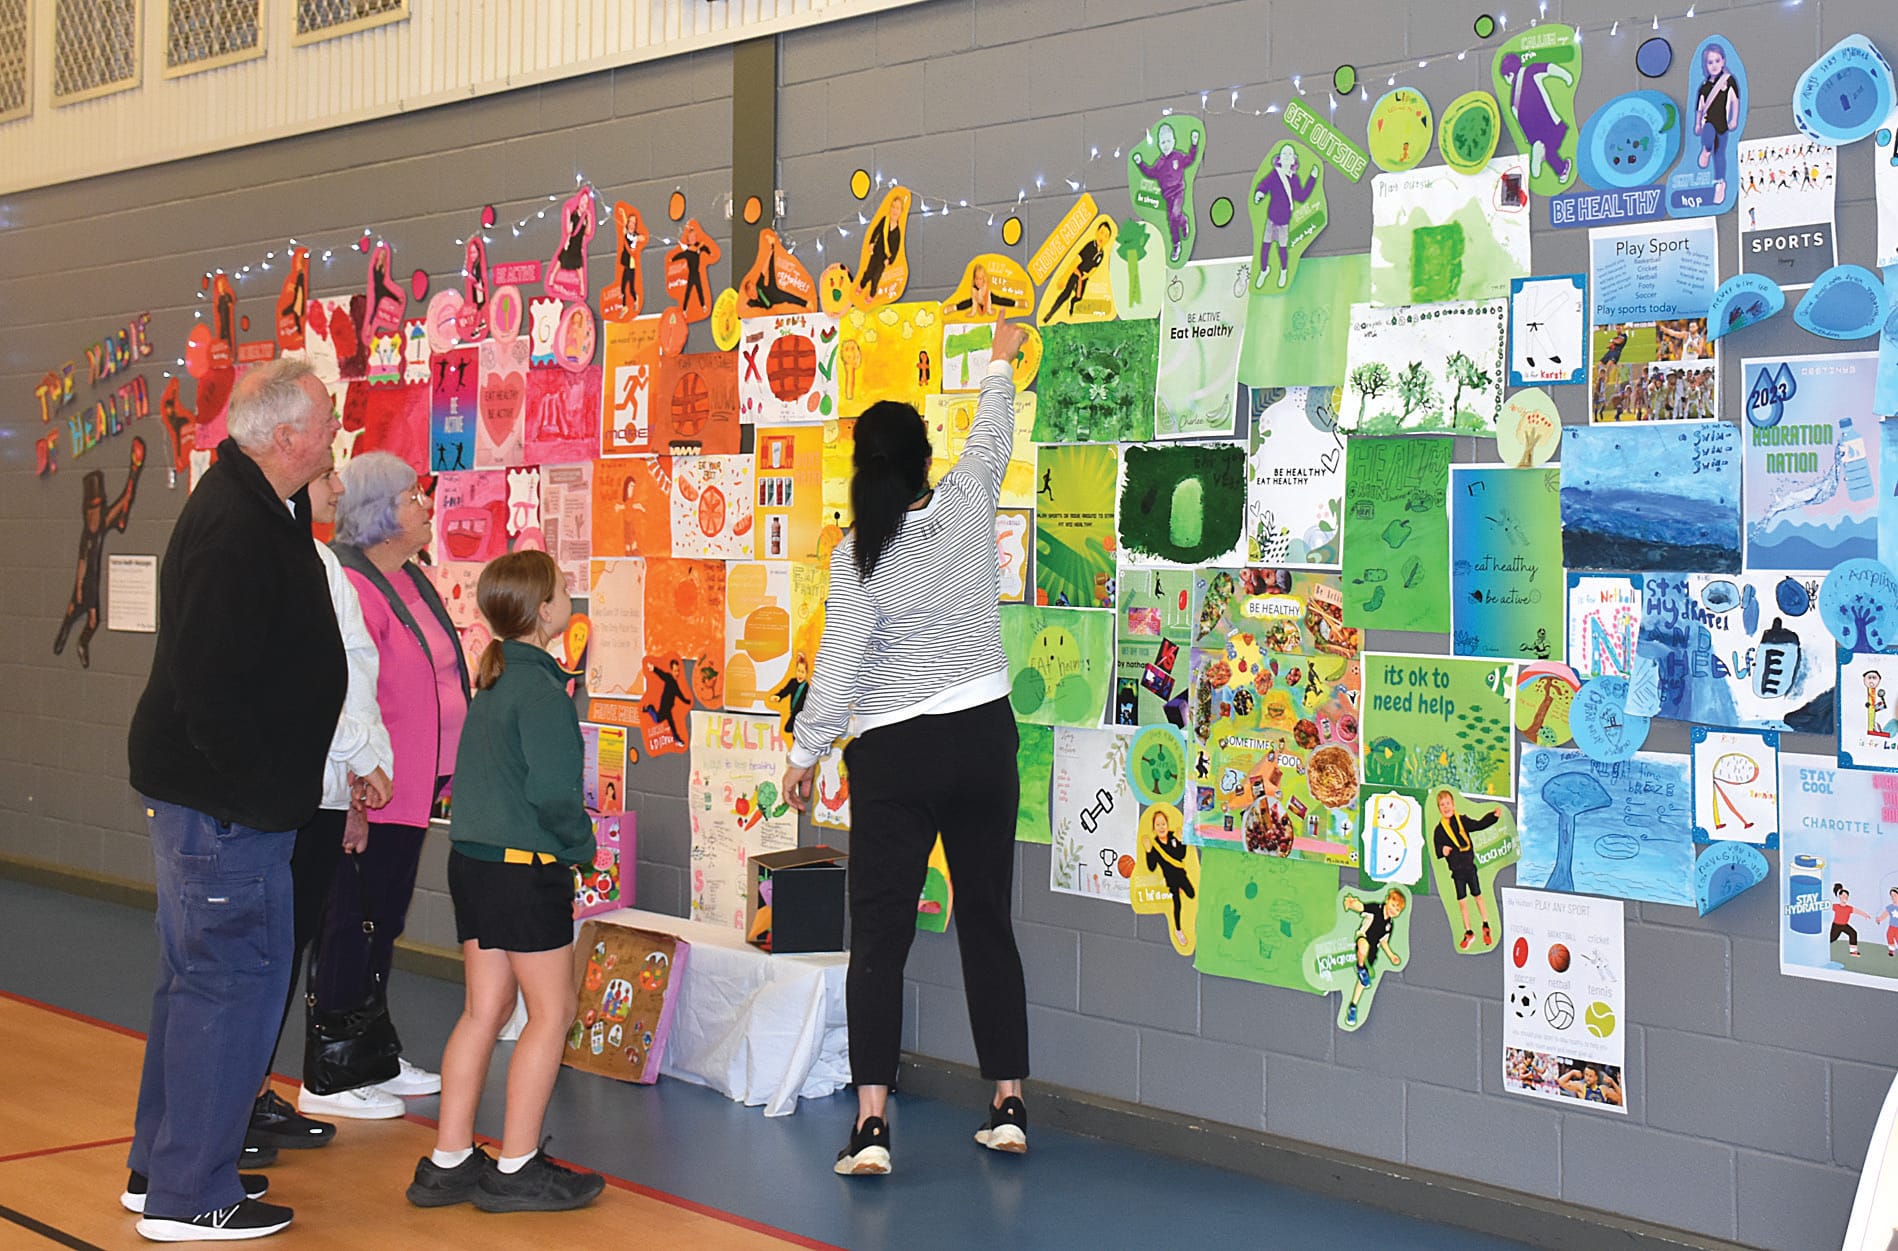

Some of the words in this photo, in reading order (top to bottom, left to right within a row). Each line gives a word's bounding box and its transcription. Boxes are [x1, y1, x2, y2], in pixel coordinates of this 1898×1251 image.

[1284, 102, 1315, 135] GET
[1310, 123, 1367, 180] OUTSIDE
[1553, 199, 1576, 224] BE
[1578, 189, 1661, 221] HEALTHY
[1681, 194, 1702, 208] hop
[1032, 233, 1066, 280] MOVE
[1060, 200, 1093, 240] MORE
[1616, 241, 1645, 258] Play
[1649, 238, 1689, 257] Sport
[1752, 232, 1823, 253] SPORTS
[1635, 291, 1657, 299] Soccer
[1187, 313, 1196, 323] BE
[1198, 311, 1221, 323] ACTIVE
[1597, 304, 1615, 317] Play
[1618, 305, 1647, 316] sports
[1649, 302, 1677, 315] today
[1170, 328, 1189, 340] Eat
[1191, 323, 1234, 340] Healthy
[1751, 383, 1787, 409] 2023
[68, 375, 149, 459] HEALTH
[1752, 424, 1833, 447] HYDRATION
[1766, 452, 1818, 474] NATION
[1274, 468, 1284, 476] BE
[1286, 468, 1326, 477] HEALTHY
[1257, 477, 1270, 485] EAT
[1272, 477, 1308, 486] HEALTHY
[1474, 554, 1490, 571] eat
[1492, 554, 1539, 582] healthy
[1486, 589, 1500, 605] be
[1501, 589, 1531, 605] active
[1249, 603, 1260, 614] BE
[1262, 603, 1300, 617] HEALTHY
[1384, 665, 1403, 686] its
[1408, 666, 1428, 687] ok
[1432, 667, 1450, 688] to
[1373, 692, 1412, 713] need
[1418, 693, 1455, 722] help
[705, 715, 783, 753] HEALTH
[1800, 769, 1835, 782] STAY
[1802, 781, 1834, 795] COOL
[1802, 816, 1870, 834] CHAROTTE
[1876, 823, 1883, 835] L
[1534, 899, 1551, 911] PLAY
[1552, 902, 1566, 913] ANY
[1567, 903, 1591, 916] SPORT
[1796, 893, 1818, 905] STAY
[1784, 900, 1831, 916] HYDRATED
[1588, 984, 1614, 998] tennis
